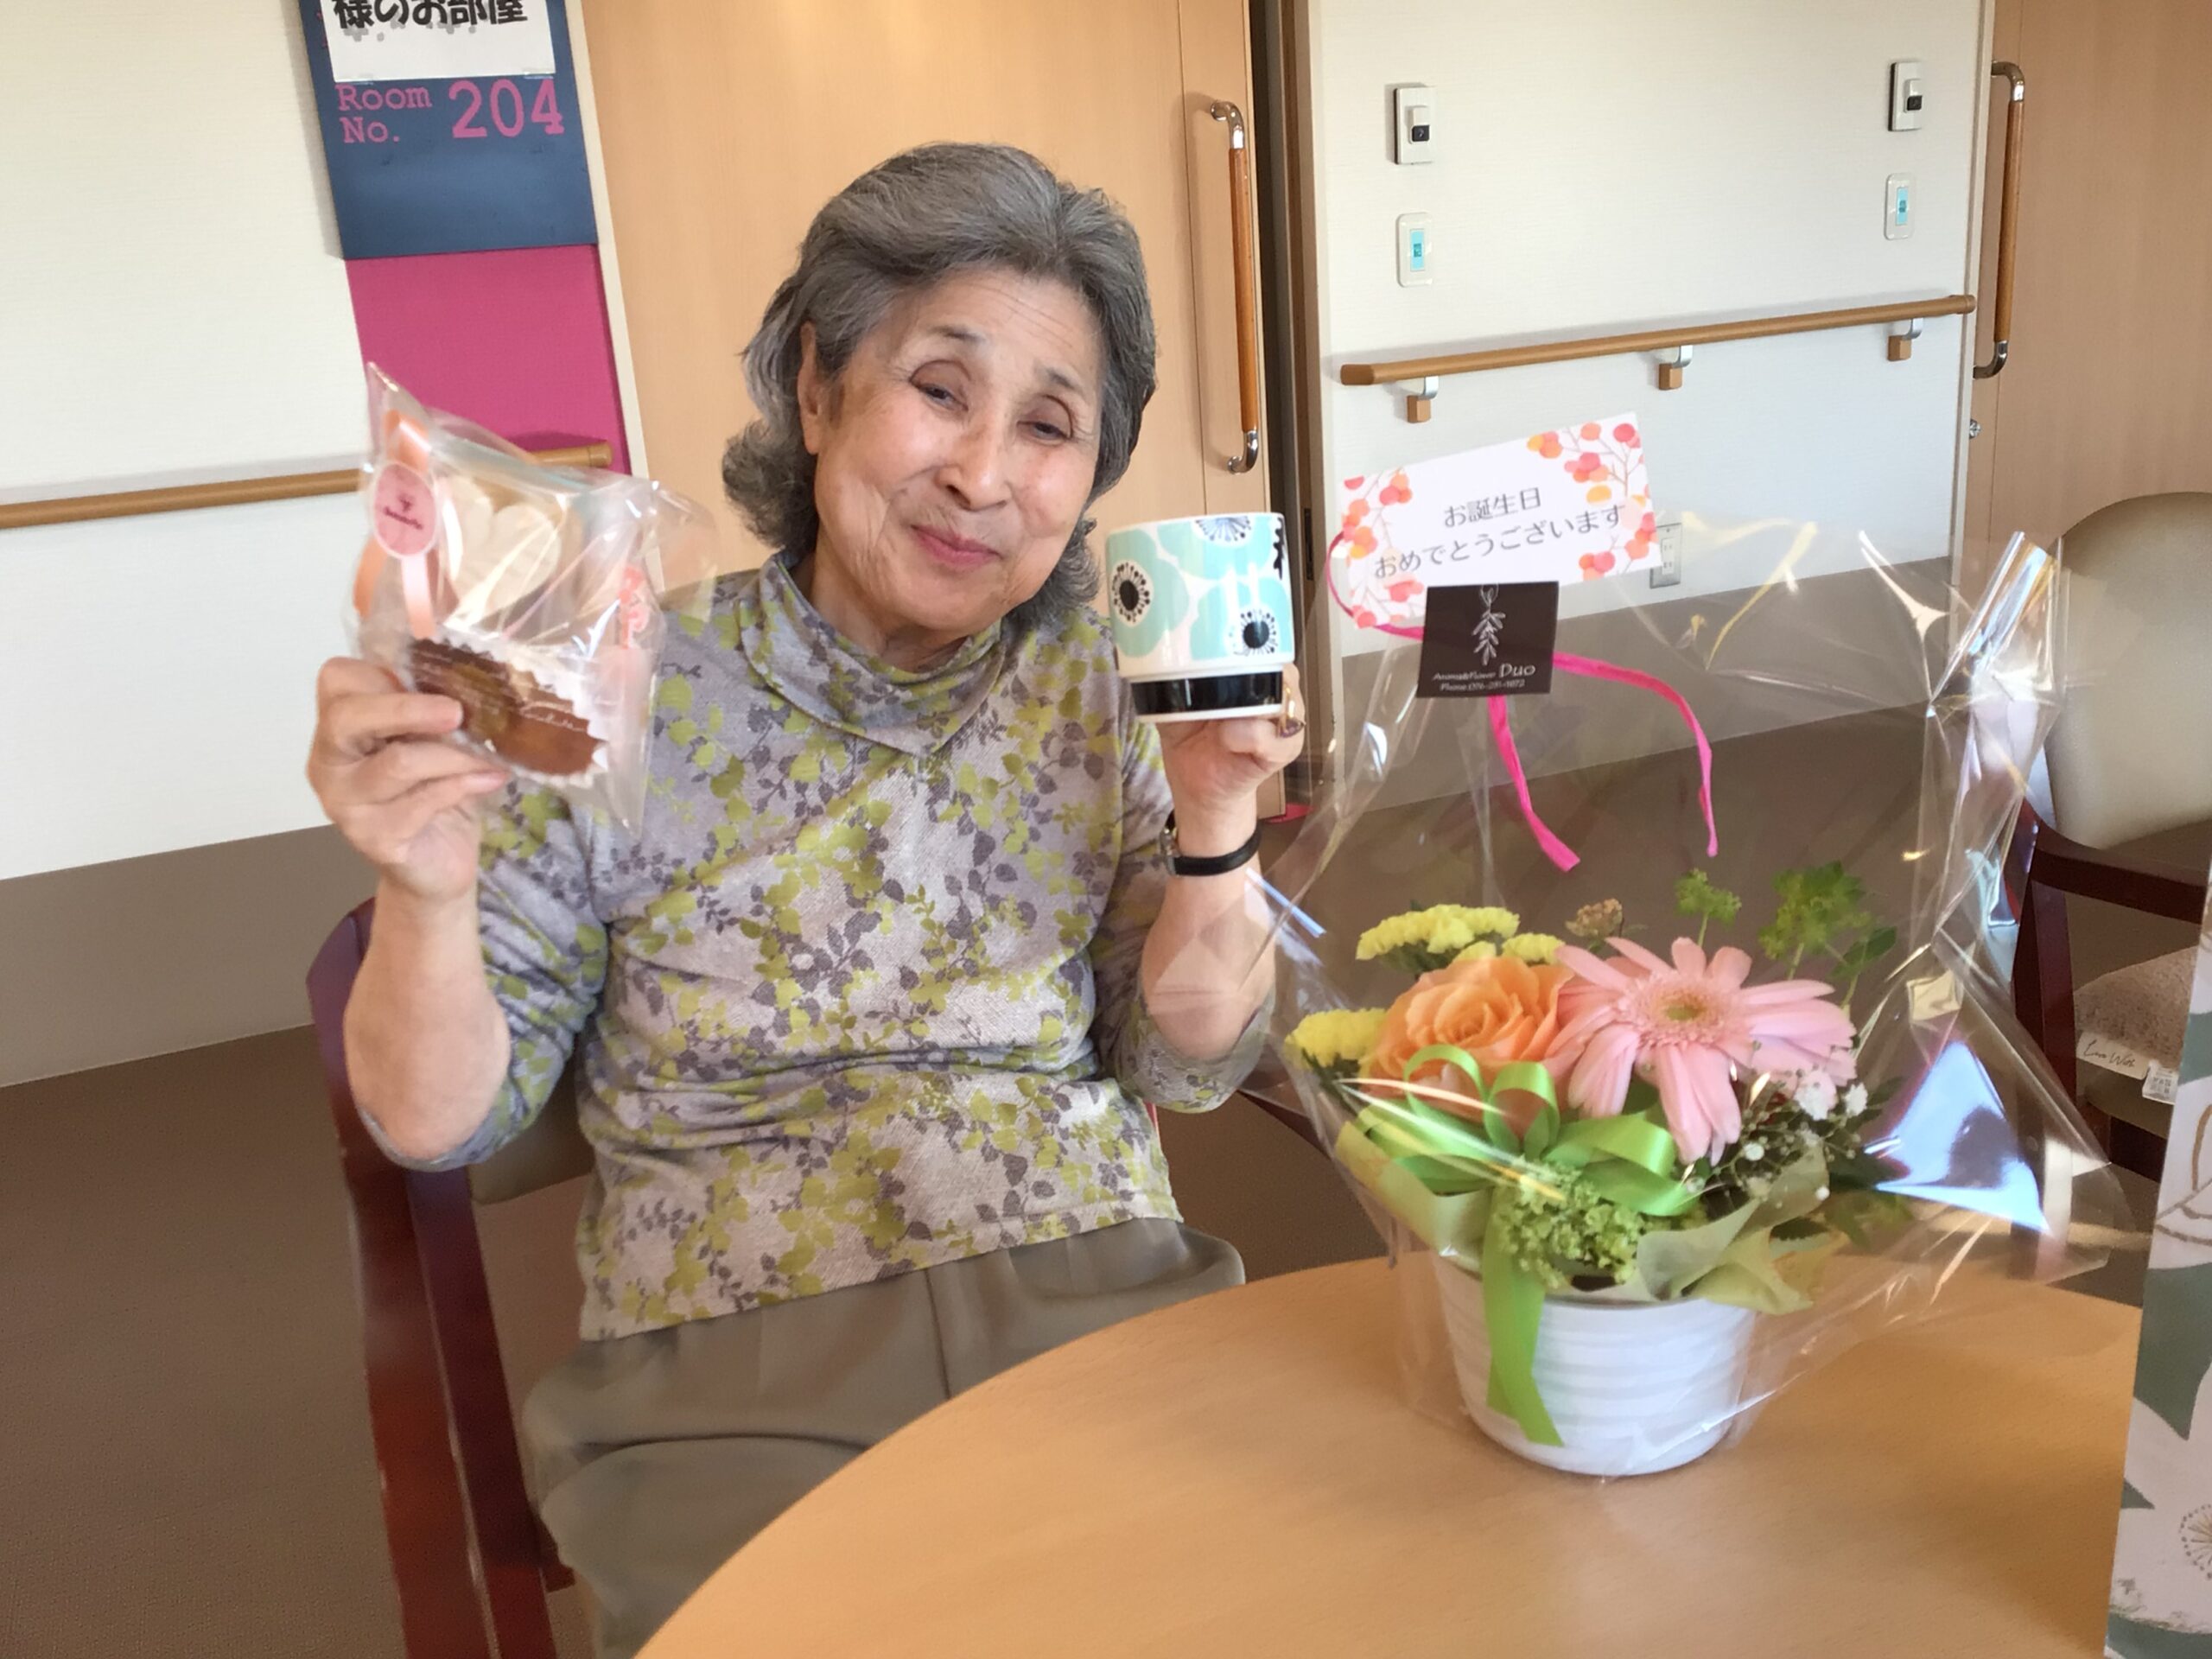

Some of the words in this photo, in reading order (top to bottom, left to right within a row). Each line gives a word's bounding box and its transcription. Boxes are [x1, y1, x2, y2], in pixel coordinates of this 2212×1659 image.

[334, 84, 433, 111] Room
[448, 78, 565, 138] 204
[339, 117, 401, 143] No.
[1444, 486, 1541, 528] お誕生日
[1374, 504, 1625, 580] おめでとうございます
[1498, 663, 1536, 678] Duo
